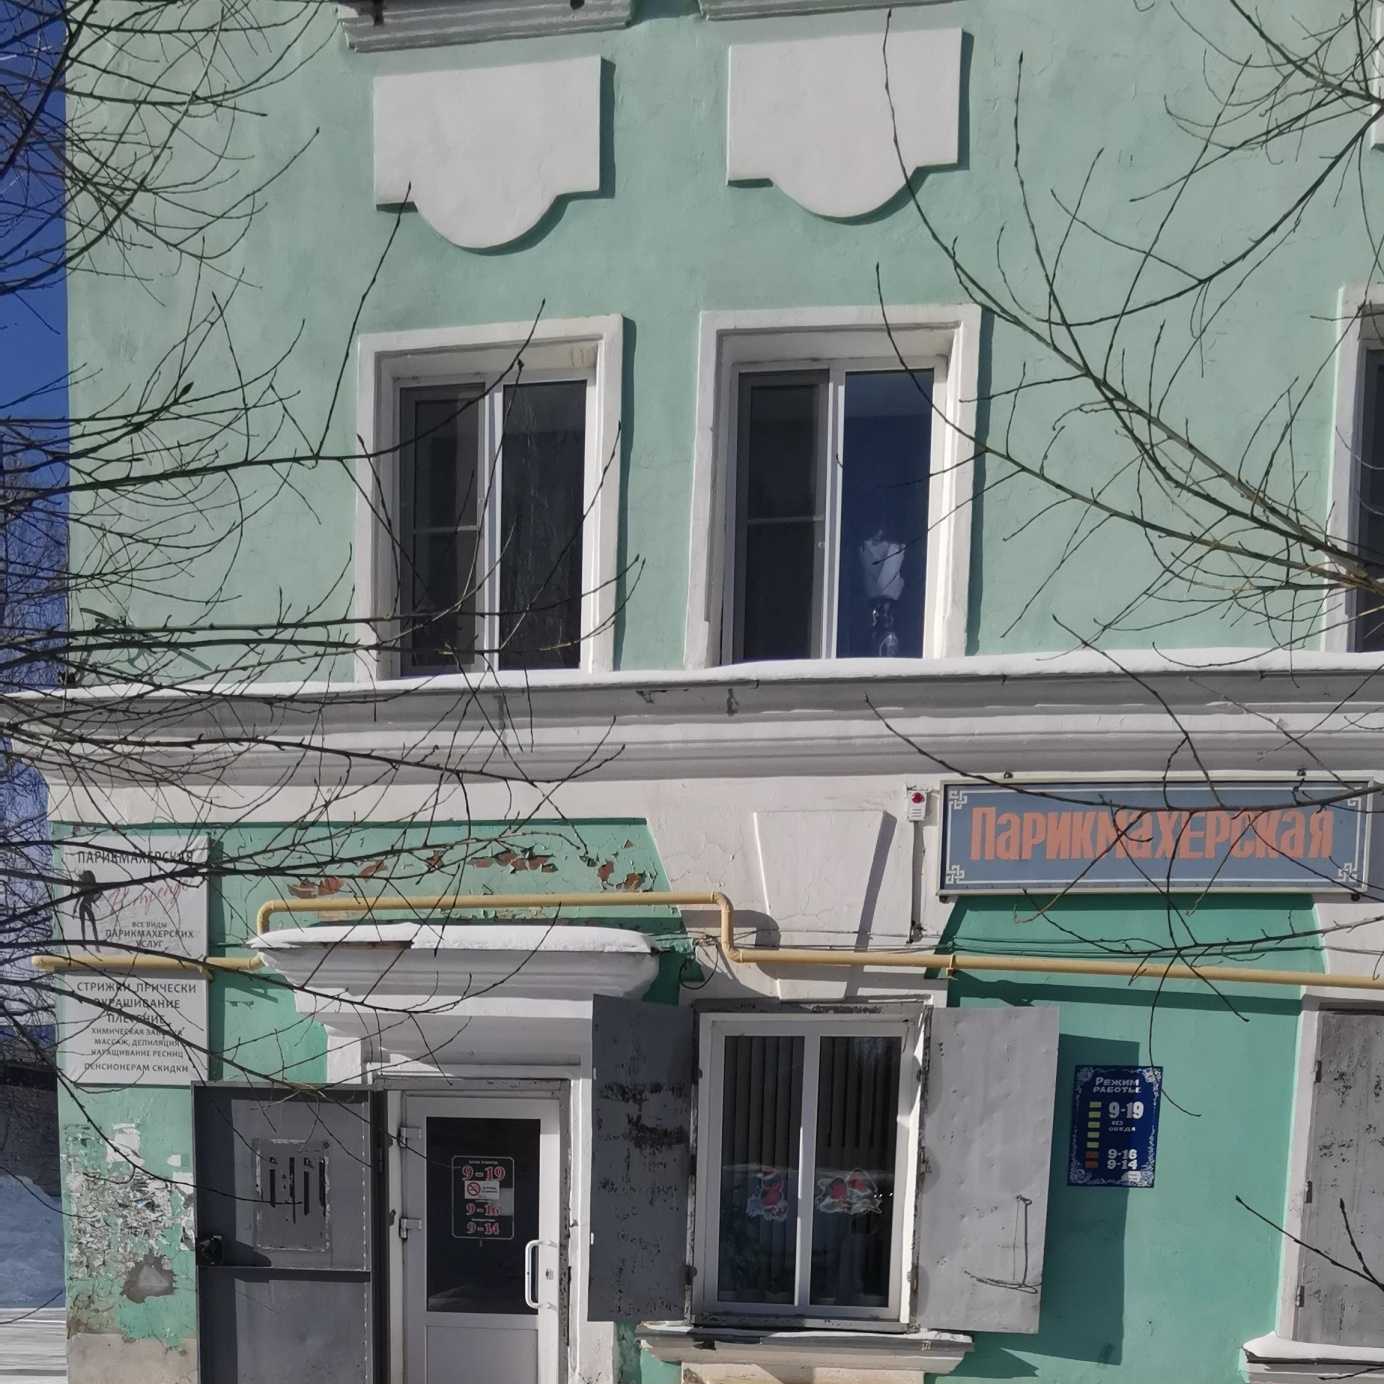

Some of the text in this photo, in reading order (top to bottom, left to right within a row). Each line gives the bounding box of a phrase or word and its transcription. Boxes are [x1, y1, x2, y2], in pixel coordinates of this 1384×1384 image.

[105, 929, 194, 938] ПАРИКМАХЕРСКИХ
[136, 983, 197, 994] ПРИЧЕСКИ
[91, 1027, 144, 1036] ХИМИЧЕСКАЯ
[84, 1063, 189, 1074] ПЕНСИОНЕРАМ СКИДКИ
[1108, 1101, 1144, 1119] 9-19
[1107, 1148, 1138, 1159] 9-16
[1106, 1159, 1138, 1169] 9-14
